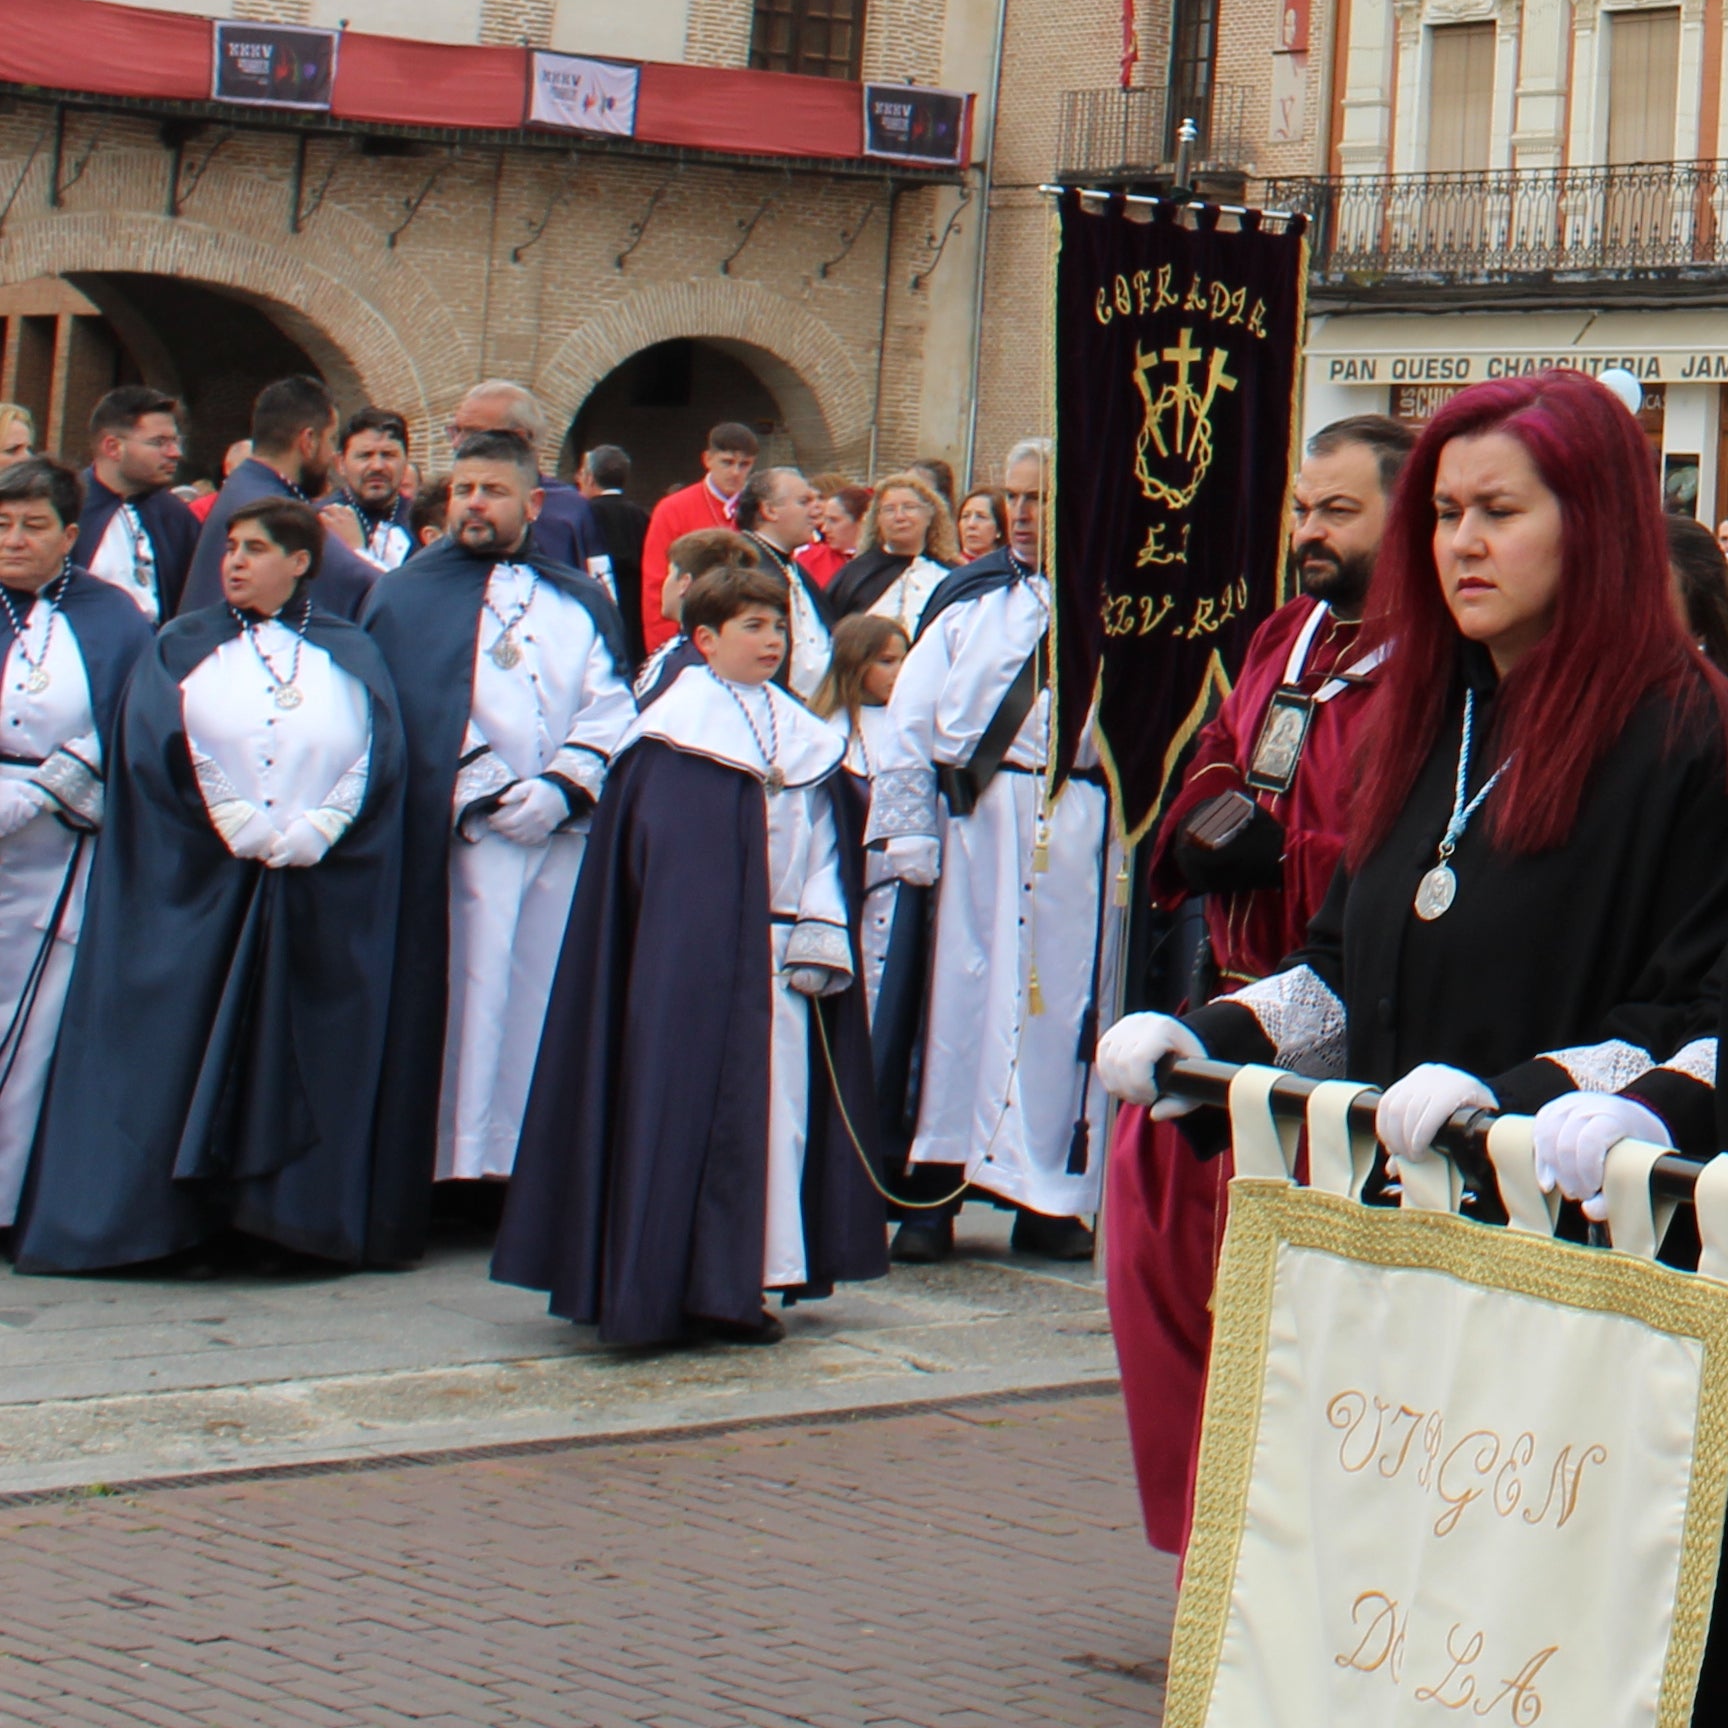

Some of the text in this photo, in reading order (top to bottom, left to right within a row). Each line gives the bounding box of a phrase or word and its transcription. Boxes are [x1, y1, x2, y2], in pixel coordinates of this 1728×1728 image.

[1096, 263, 1266, 338] COFRADIA
[1330, 359, 1377, 380] PAN
[1391, 358, 1470, 380] QUESO
[1400, 386, 1415, 417] LOS
[1415, 1622, 1559, 1728] LA
